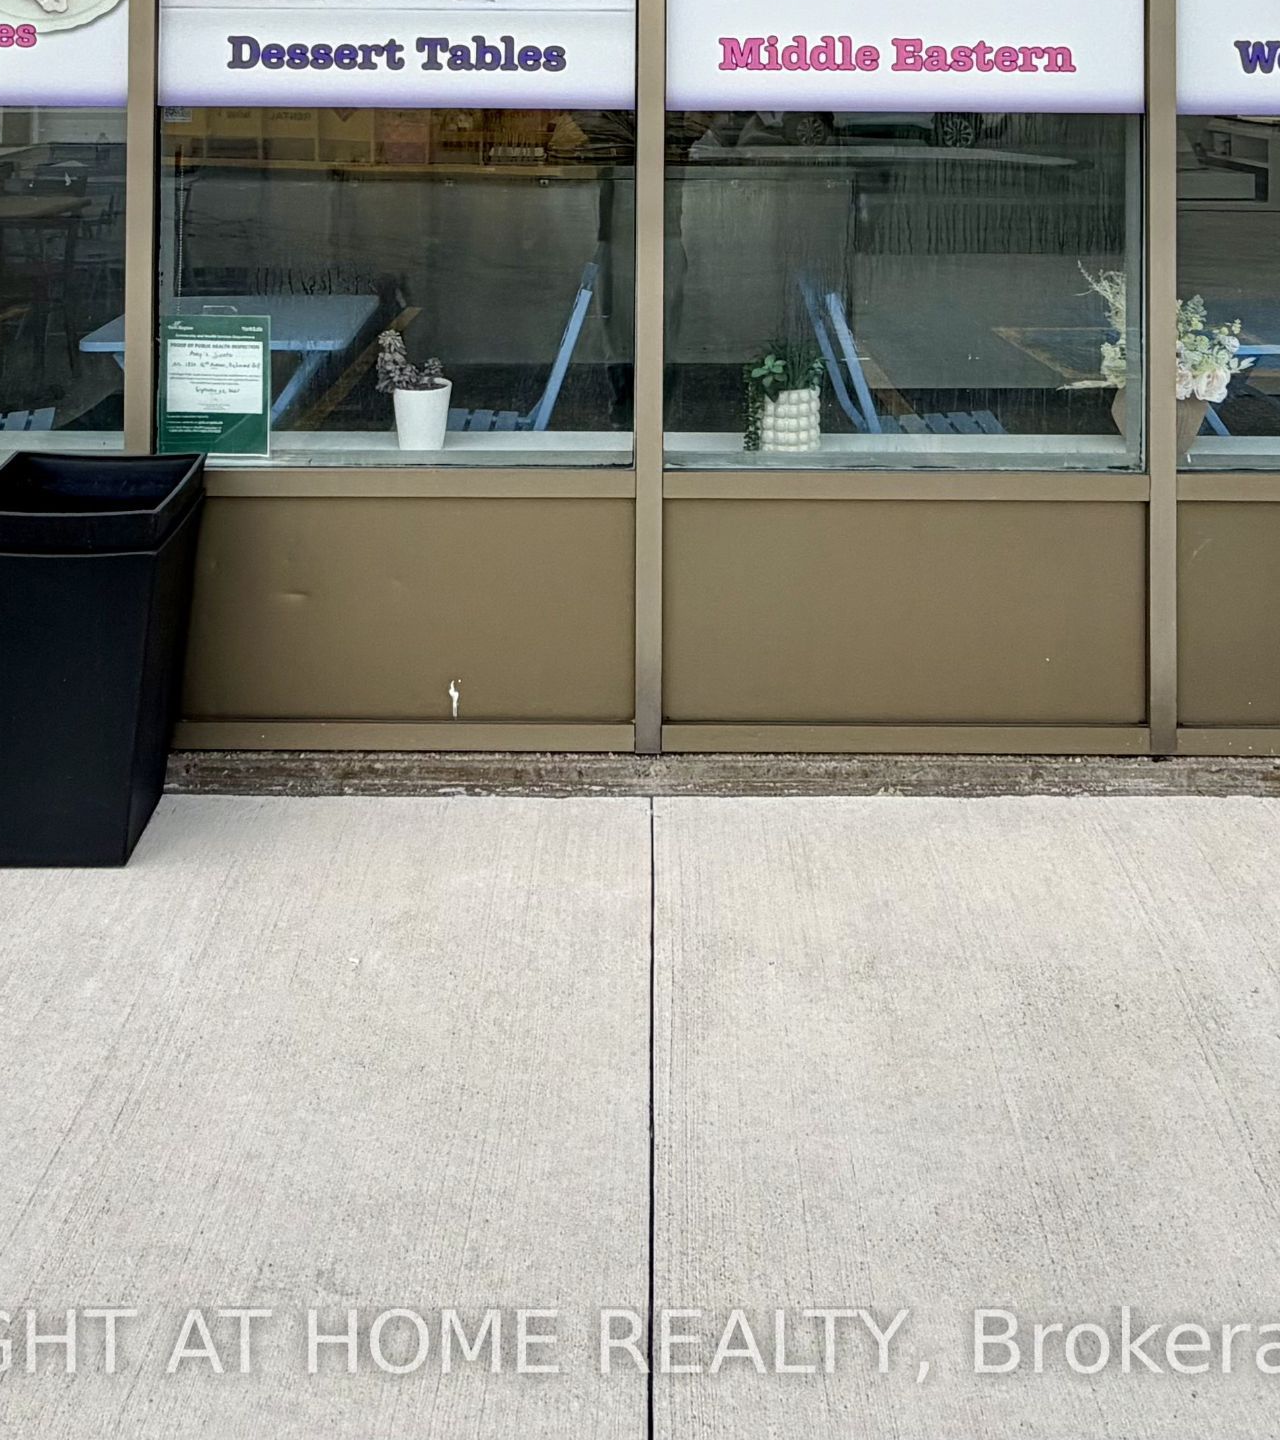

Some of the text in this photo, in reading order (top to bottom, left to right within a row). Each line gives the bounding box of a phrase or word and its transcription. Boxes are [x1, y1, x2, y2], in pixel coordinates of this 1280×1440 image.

[227, 35, 567, 72] Dessert Tables
[718, 35, 1078, 73] Middle Eastern
